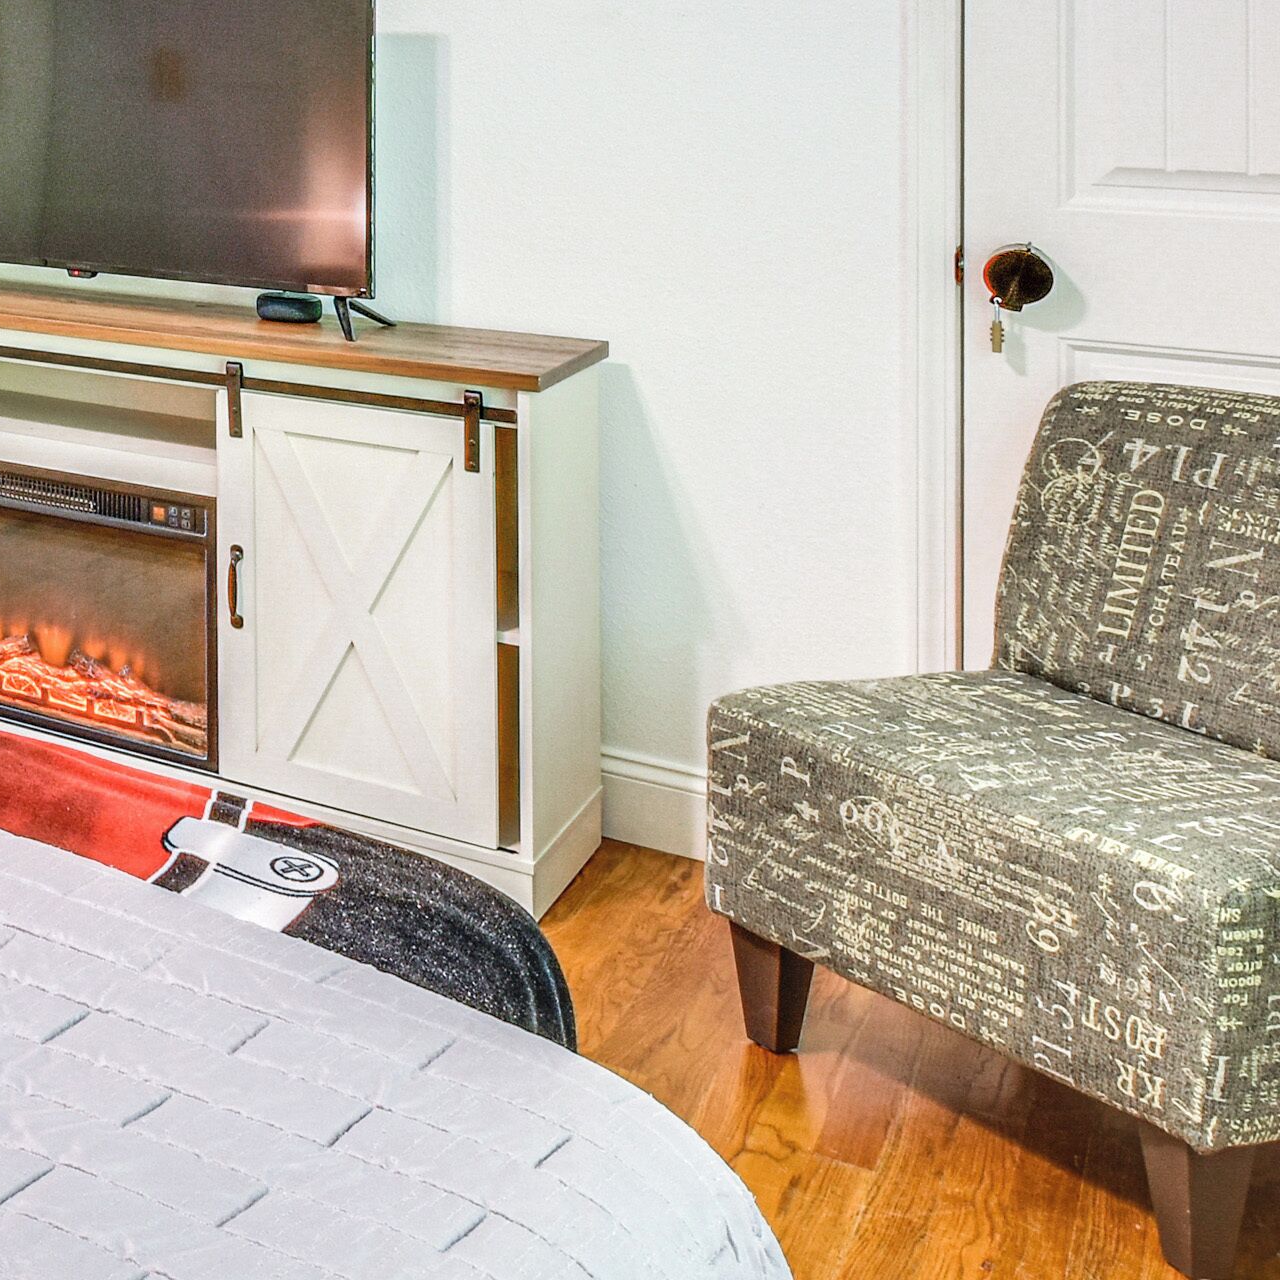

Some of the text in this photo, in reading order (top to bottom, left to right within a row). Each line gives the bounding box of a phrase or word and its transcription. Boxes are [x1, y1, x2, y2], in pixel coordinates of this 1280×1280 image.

[1116, 394, 1146, 405] one
[1206, 406, 1227, 415] an
[1120, 408, 1207, 431] DOSE.
[1232, 411, 1261, 423] For
[1096, 488, 1167, 640] LIMITED
[1147, 525, 1188, 628] CHATEAU
[880, 906, 896, 921] or
[920, 901, 943, 923] THE
[905, 916, 947, 943] water
[956, 915, 997, 945] SHAKE
[1222, 927, 1265, 942] taken
[900, 942, 920, 960] for
[957, 937, 972, 954] in
[873, 944, 913, 972] times
[876, 959, 901, 979] one
[982, 947, 1025, 976] taken
[1226, 959, 1263, 973] after
[915, 961, 955, 990] three
[1218, 974, 1262, 989] spoon
[958, 979, 1023, 1020] spoonful
[985, 978, 1024, 1004] after
[1222, 993, 1249, 1007] For
[956, 994, 975, 1011] an
[982, 1005, 1008, 1028] For
[1081, 995, 1168, 1060] POST
